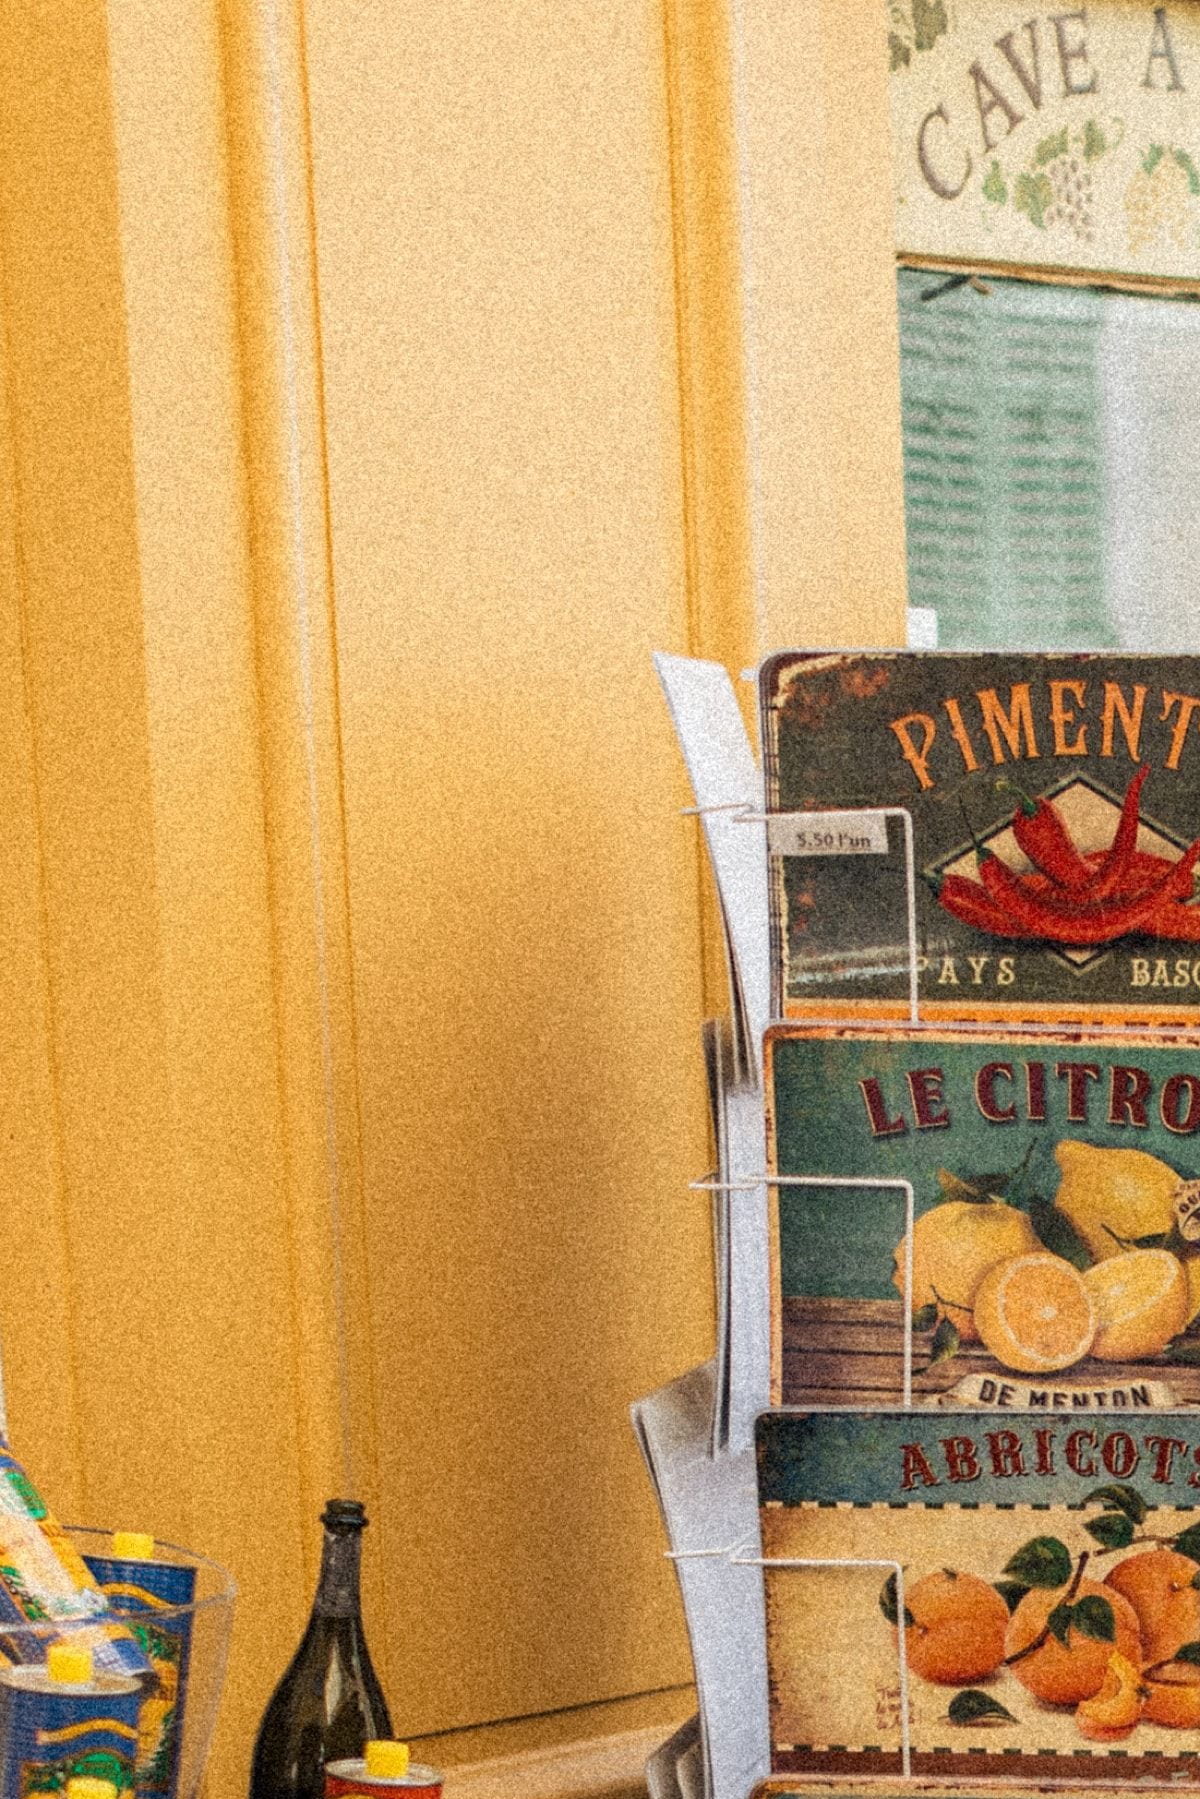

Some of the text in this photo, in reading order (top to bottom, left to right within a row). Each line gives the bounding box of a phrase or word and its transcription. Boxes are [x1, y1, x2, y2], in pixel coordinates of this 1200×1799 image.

[917, 10, 1098, 200] CAVE
[1141, 8, 1186, 93] A
[858, 1067, 952, 1138] LE
[978, 1379, 1150, 1407] DE MENTON
